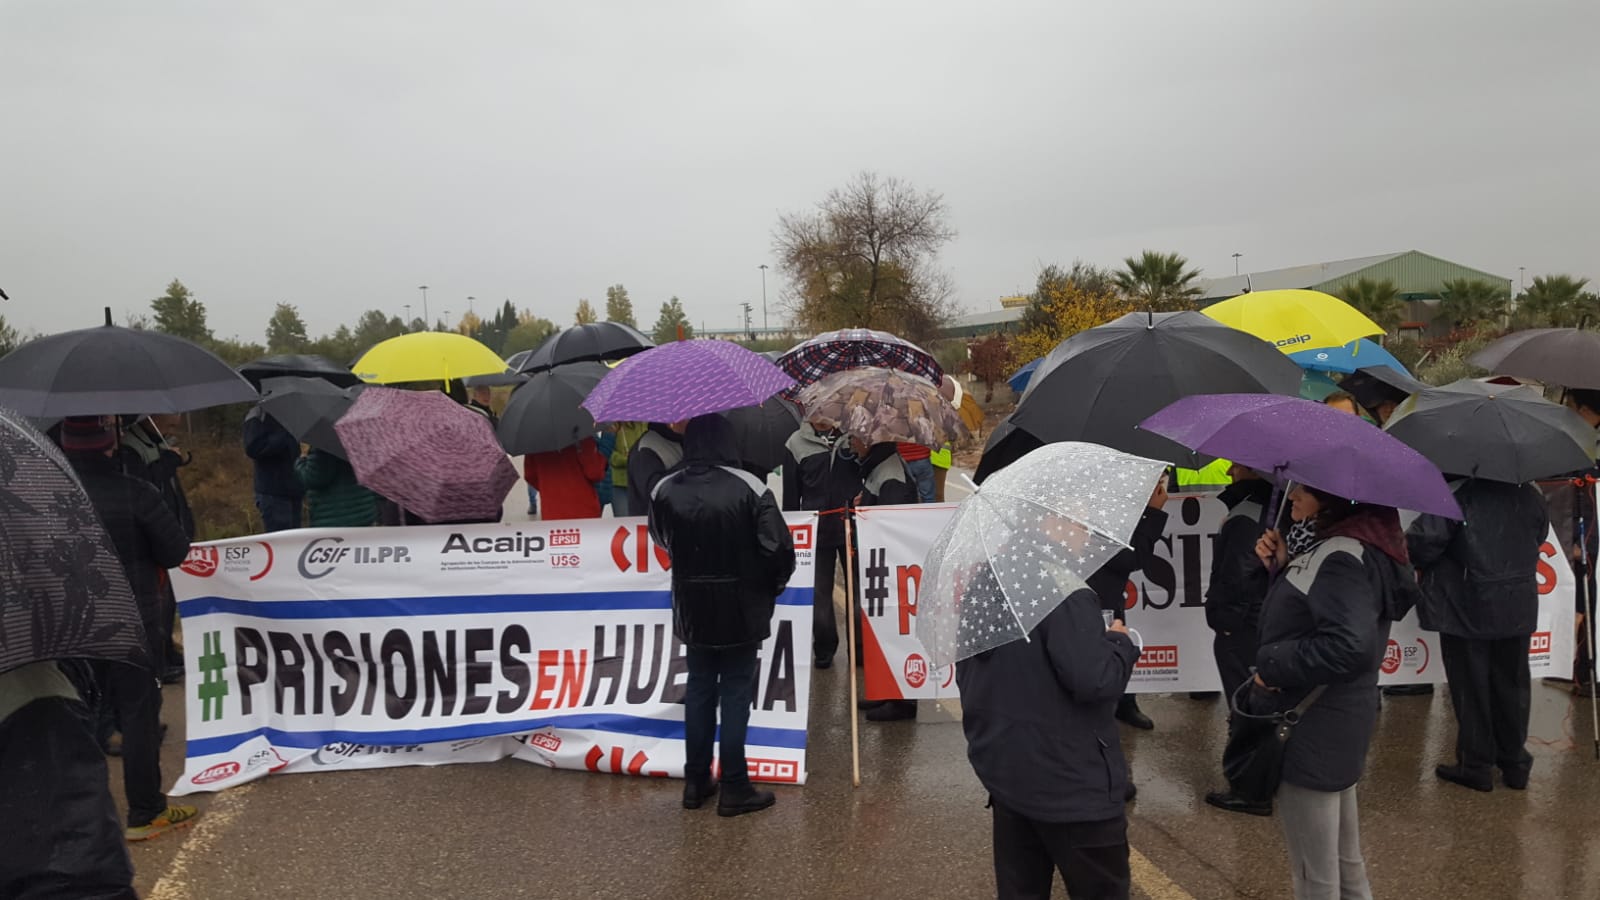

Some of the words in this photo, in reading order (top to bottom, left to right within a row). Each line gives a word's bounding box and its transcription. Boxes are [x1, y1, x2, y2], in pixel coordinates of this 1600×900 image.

[1273, 334, 1311, 348] caip
[440, 531, 545, 557] Acaip
[552, 535, 577, 545] EPSU
[225, 547, 250, 559] ESP
[308, 547, 351, 564] CSIF
